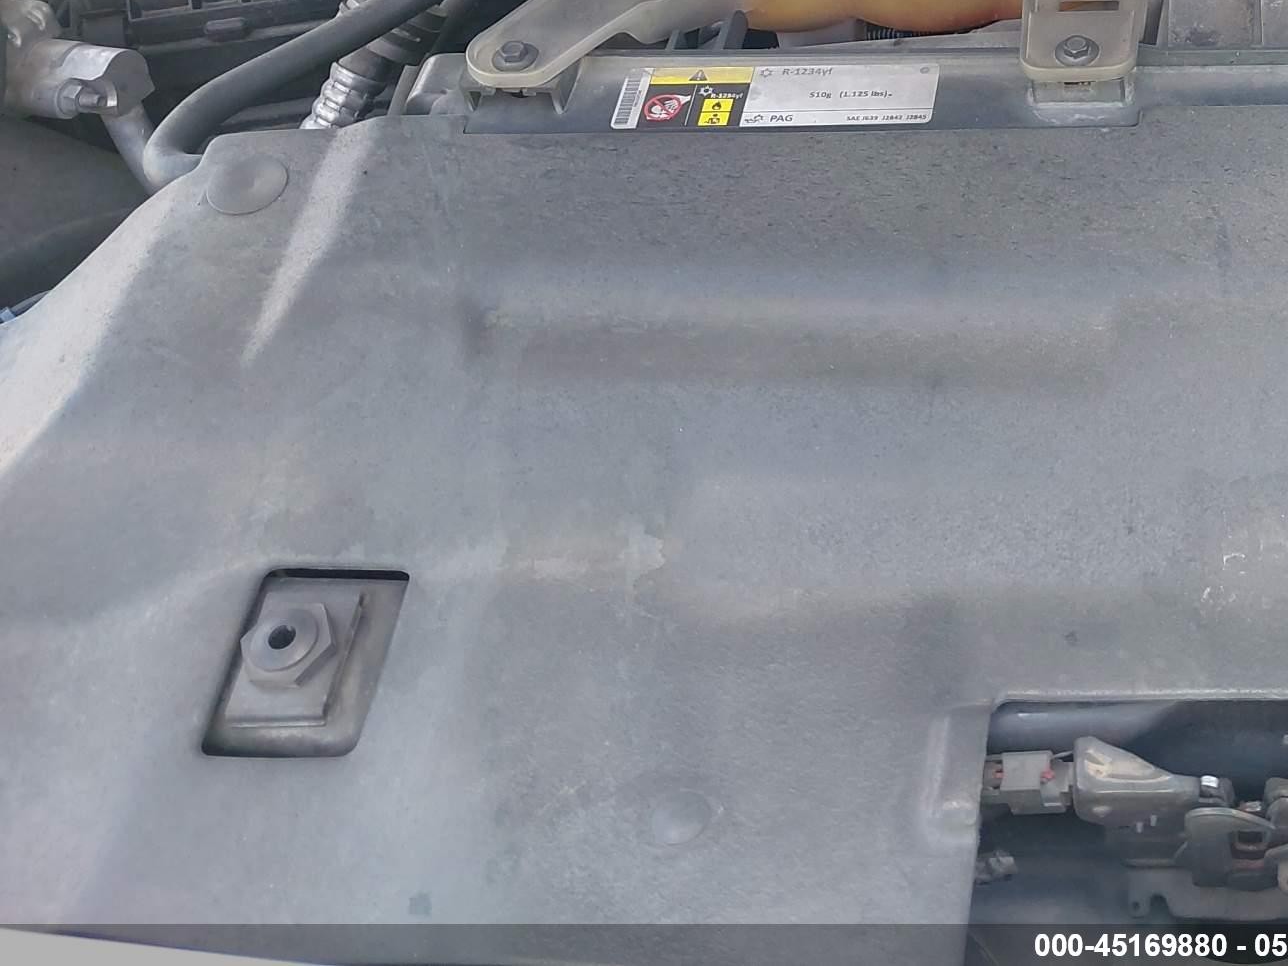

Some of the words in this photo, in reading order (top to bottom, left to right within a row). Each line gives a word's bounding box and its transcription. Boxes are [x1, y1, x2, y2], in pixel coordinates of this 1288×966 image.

[782, 67, 833, 77] R-1234yf
[808, 91, 832, 99] 510g
[769, 114, 793, 123] PAG
